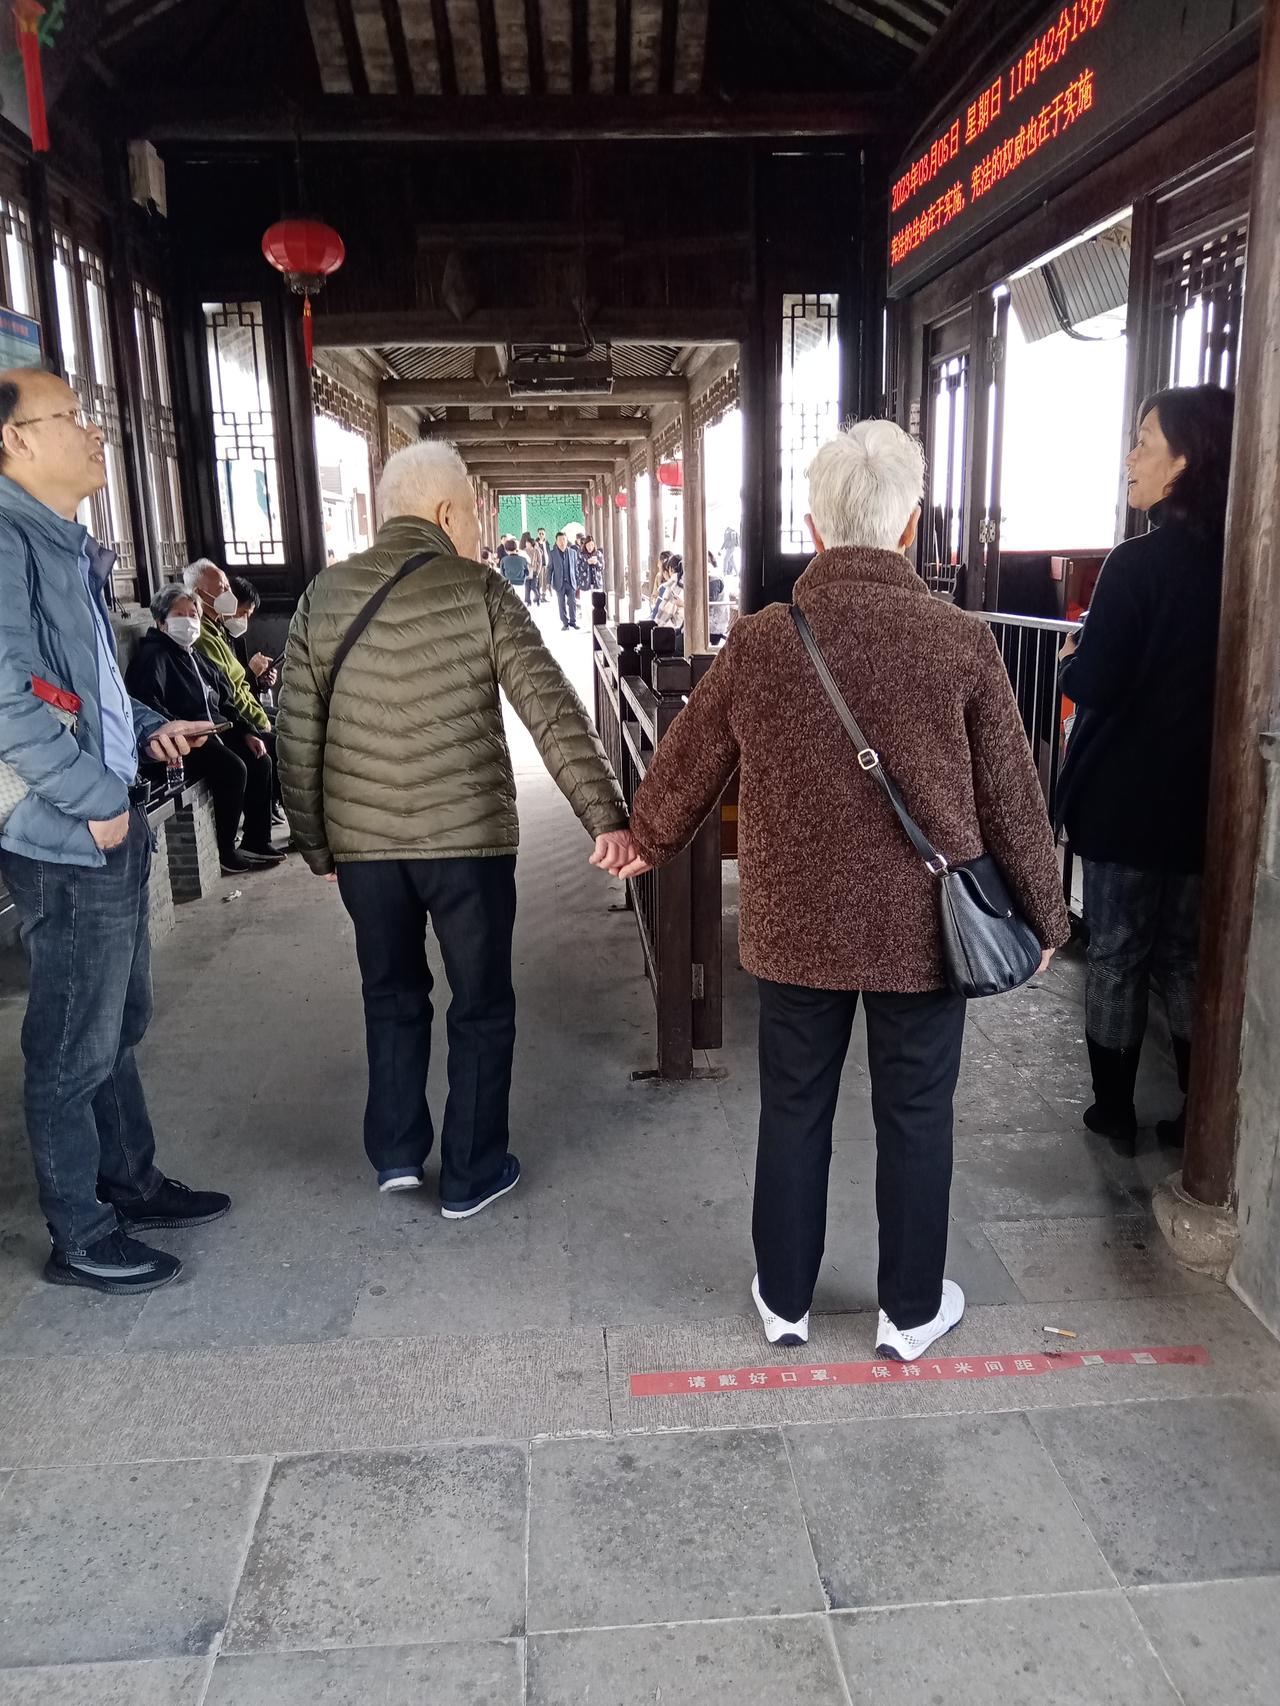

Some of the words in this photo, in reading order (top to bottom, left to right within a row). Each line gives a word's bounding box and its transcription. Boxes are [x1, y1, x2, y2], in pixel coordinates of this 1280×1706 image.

[891, 118, 960, 212] 2023年03月05日
[964, 75, 1002, 145] 星期日
[971, 67, 1094, 203] 宪法的权威也在于实施
